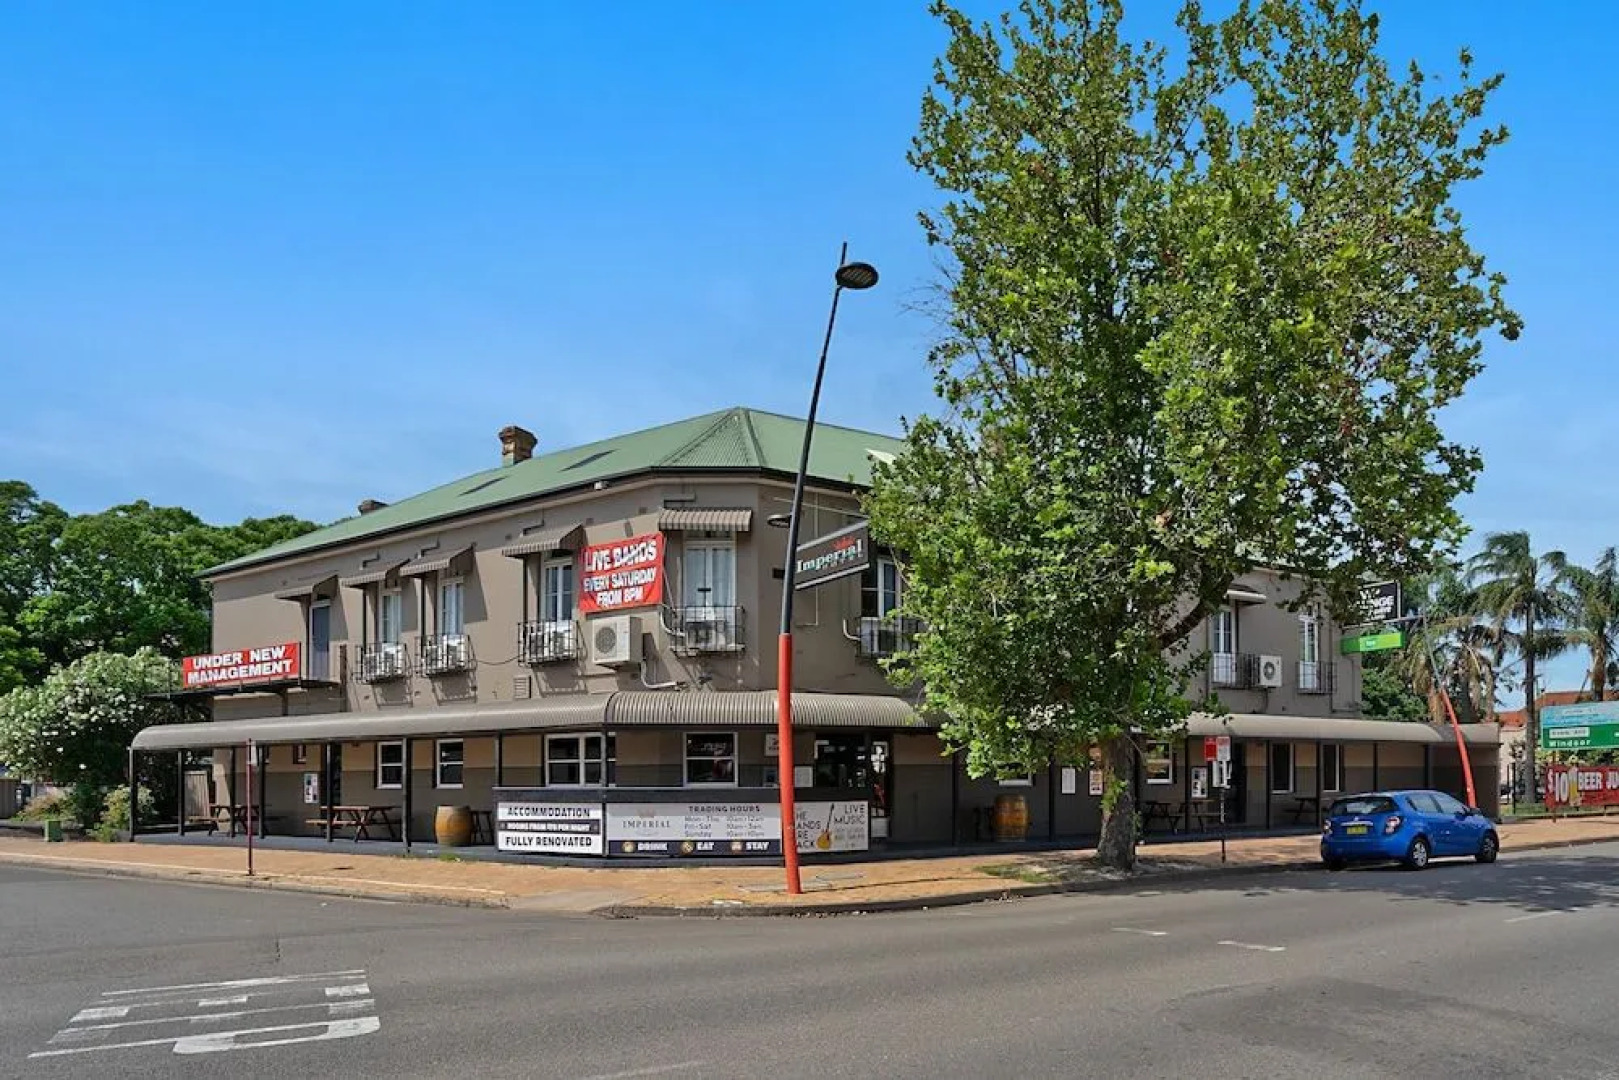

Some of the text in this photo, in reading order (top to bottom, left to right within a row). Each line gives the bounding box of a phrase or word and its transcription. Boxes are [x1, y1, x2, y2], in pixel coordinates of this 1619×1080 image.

[585, 540, 657, 572] LIVE BANDS
[583, 567, 657, 592] EVERY SATURDAY
[596, 588, 623, 605] FROM
[192, 645, 286, 669] UNDER NEW
[187, 659, 293, 684] MANAGEMENT
[1578, 771, 1603, 790] BEER
[507, 807, 590, 817] ACCOMMODATION
[844, 804, 865, 814] LIVE
[796, 810, 808, 820] HE
[833, 815, 865, 825] MUSIC
[622, 820, 670, 828] IMPERIAL
[796, 820, 821, 830] ANDS
[797, 830, 808, 839] RE
[505, 836, 592, 846] FULLY RENOVATED
[637, 841, 668, 851] DRINK
[697, 841, 715, 851] EAT
[745, 841, 770, 851] STAY
[796, 840, 815, 848] ACK
